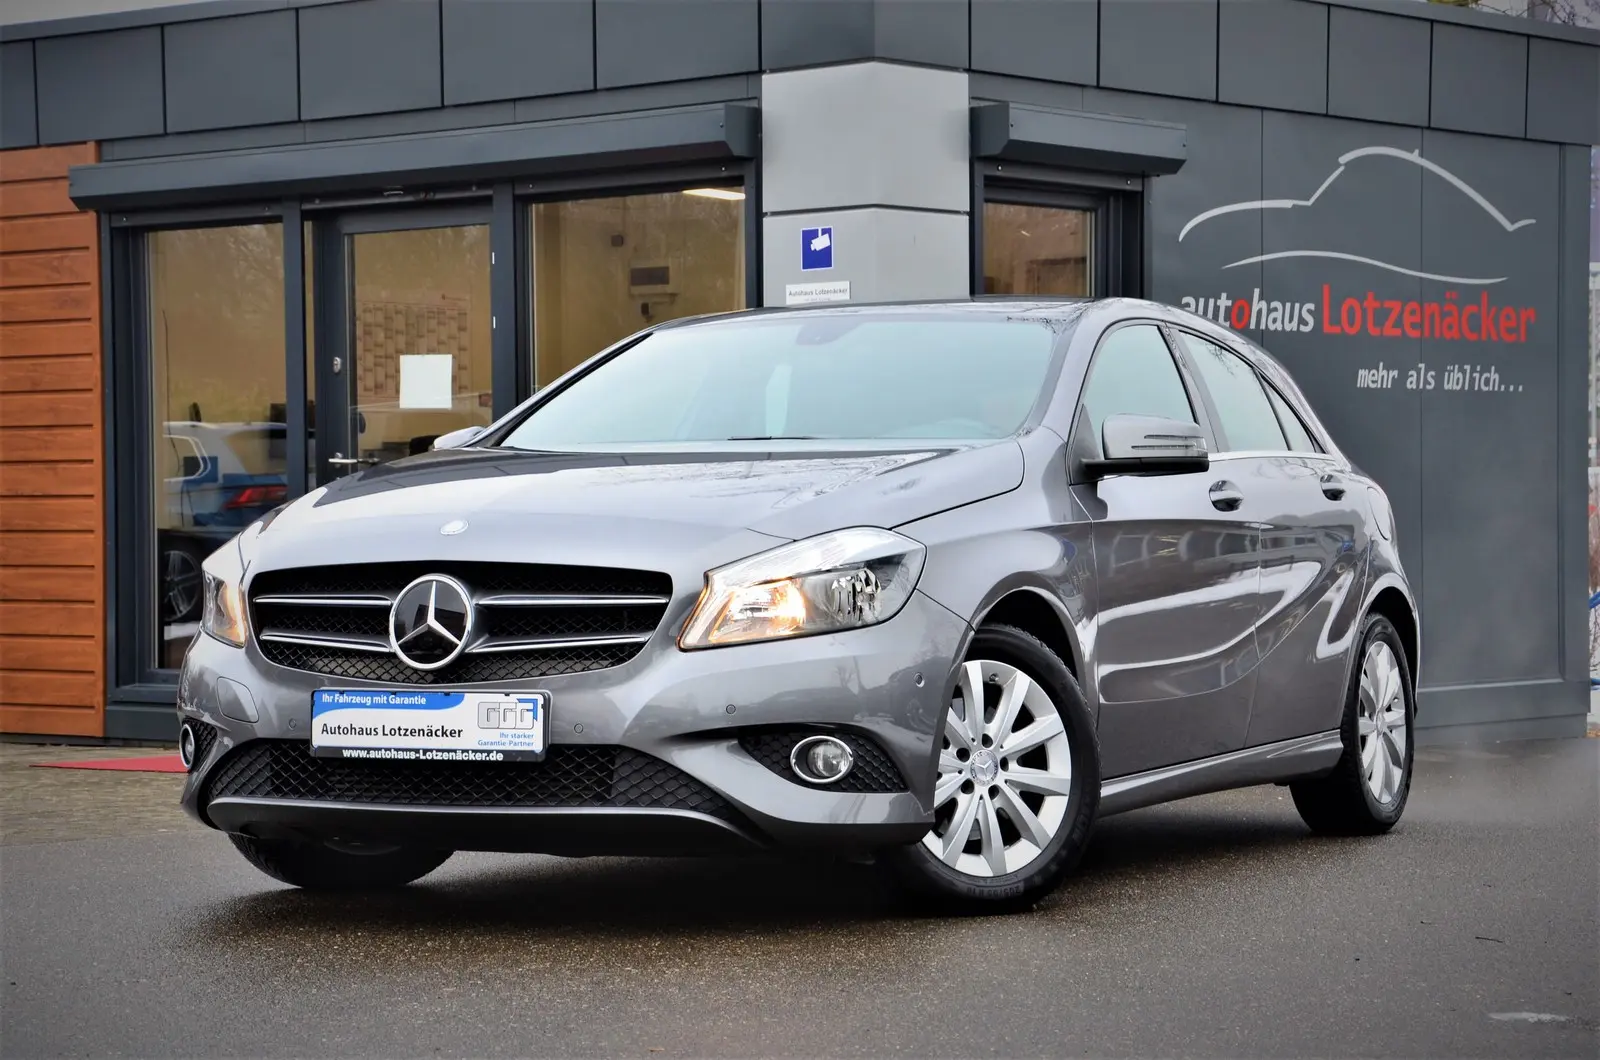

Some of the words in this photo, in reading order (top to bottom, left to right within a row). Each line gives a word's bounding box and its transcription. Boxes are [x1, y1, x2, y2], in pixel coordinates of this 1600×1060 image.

[1180, 288, 1315, 332] autohaus
[1322, 284, 1536, 342] Lotzenäcker
[1357, 362, 1398, 389] mehr
[1406, 362, 1435, 390] als
[1443, 364, 1524, 392] üblich...
[321, 694, 334, 704] Ihr
[334, 694, 371, 706] Fahrzeug
[372, 695, 387, 705] mit
[388, 695, 427, 705] Garantie
[321, 723, 379, 737] Autohaus
[382, 724, 464, 738] Lotzenäcker
[342, 748, 504, 762] www.autohaus-Lotzenäcker.de
